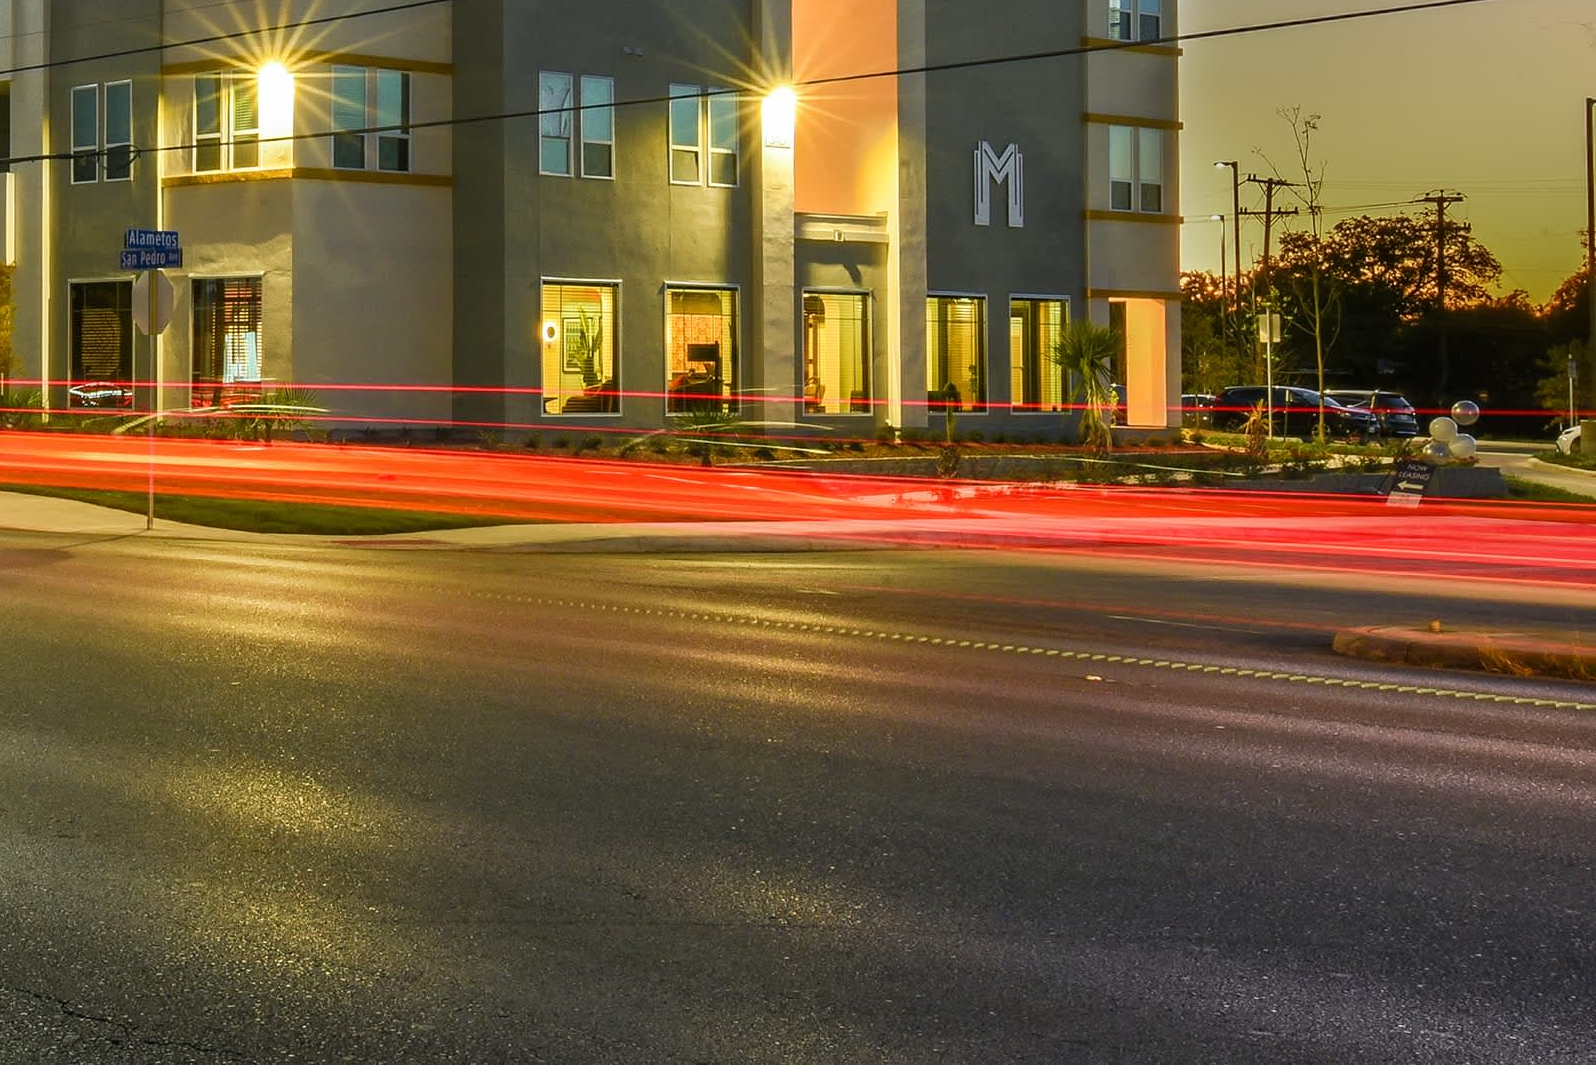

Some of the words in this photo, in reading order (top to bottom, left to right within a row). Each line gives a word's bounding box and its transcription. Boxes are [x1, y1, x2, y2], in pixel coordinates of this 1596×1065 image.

[974, 140, 1024, 228] M
[129, 230, 178, 247] Alametos
[121, 251, 137, 266] San
[140, 249, 166, 265] Pedro
[1398, 471, 1430, 481] LEASING
[1406, 464, 1429, 472] NOW
